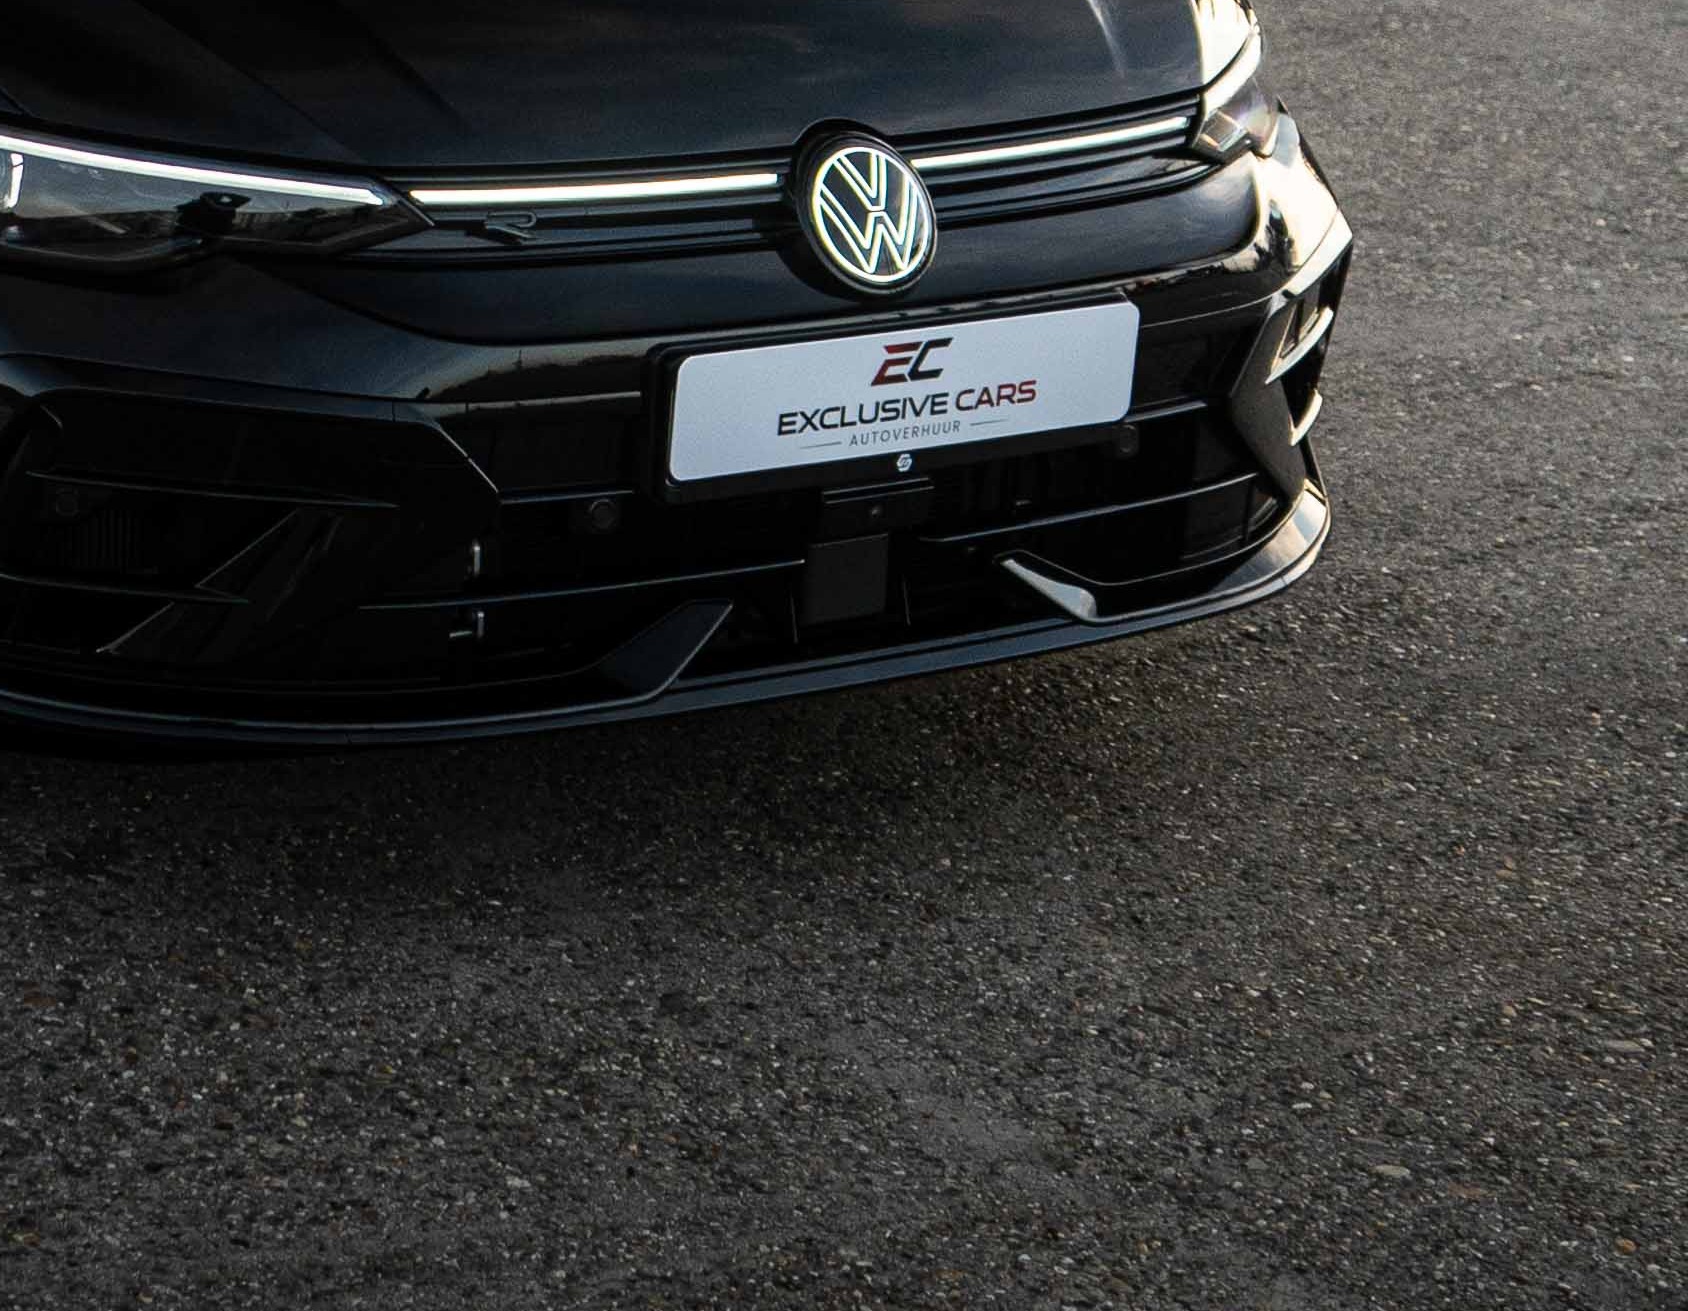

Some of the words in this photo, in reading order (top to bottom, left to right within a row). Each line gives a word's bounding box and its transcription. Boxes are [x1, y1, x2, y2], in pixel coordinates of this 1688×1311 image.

[870, 336, 954, 387] EC
[776, 392, 949, 437] EXCLUSIVE
[955, 380, 1037, 412] CARS
[849, 420, 961, 448] AUTOVERHUUR
